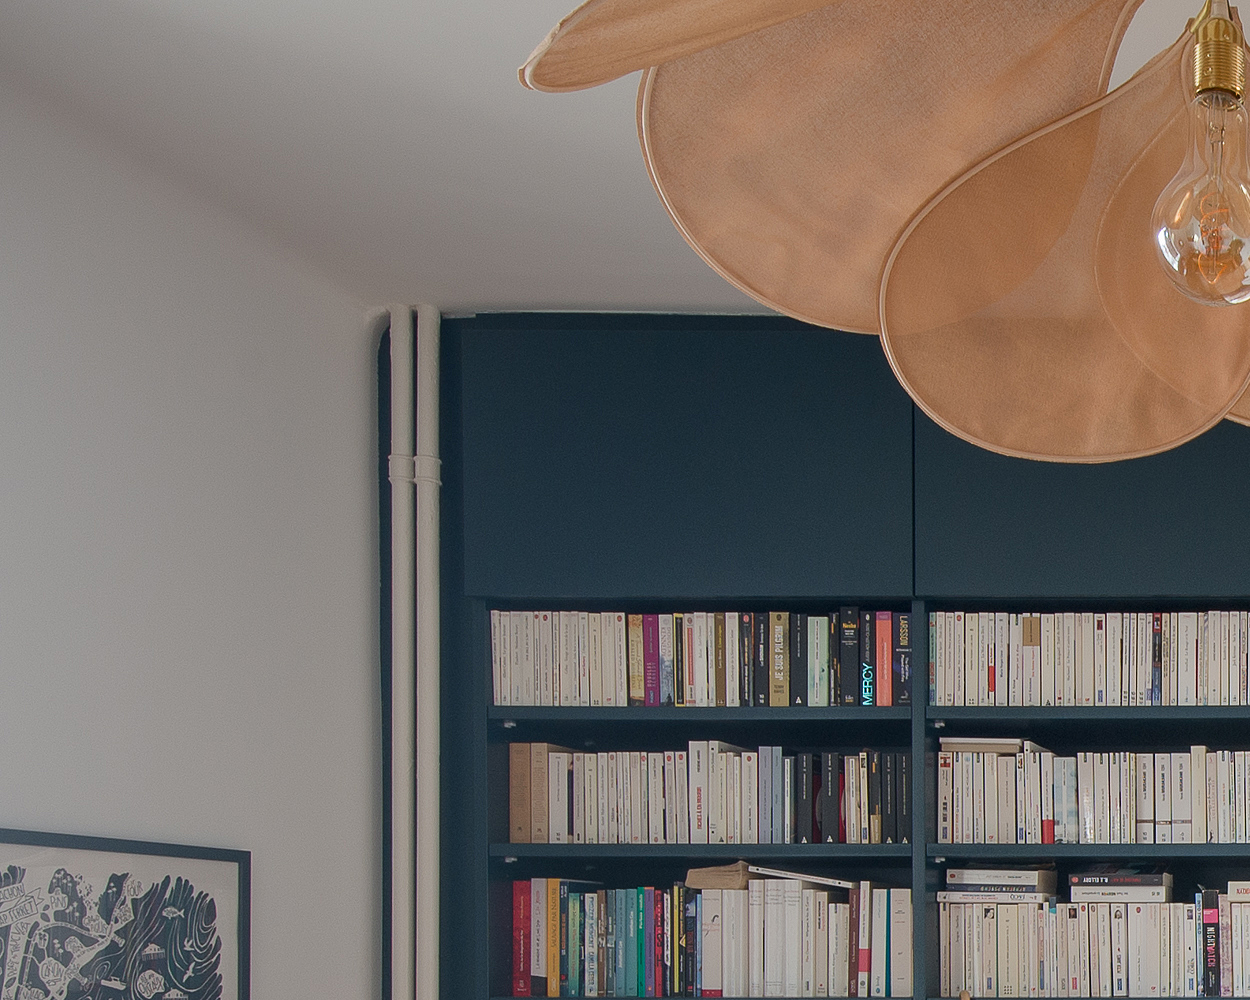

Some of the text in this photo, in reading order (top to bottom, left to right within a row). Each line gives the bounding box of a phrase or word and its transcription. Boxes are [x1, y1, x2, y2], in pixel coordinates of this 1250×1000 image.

[775, 626, 784, 680] JE SUIS PILGRIM
[862, 663, 873, 706] MERCY
